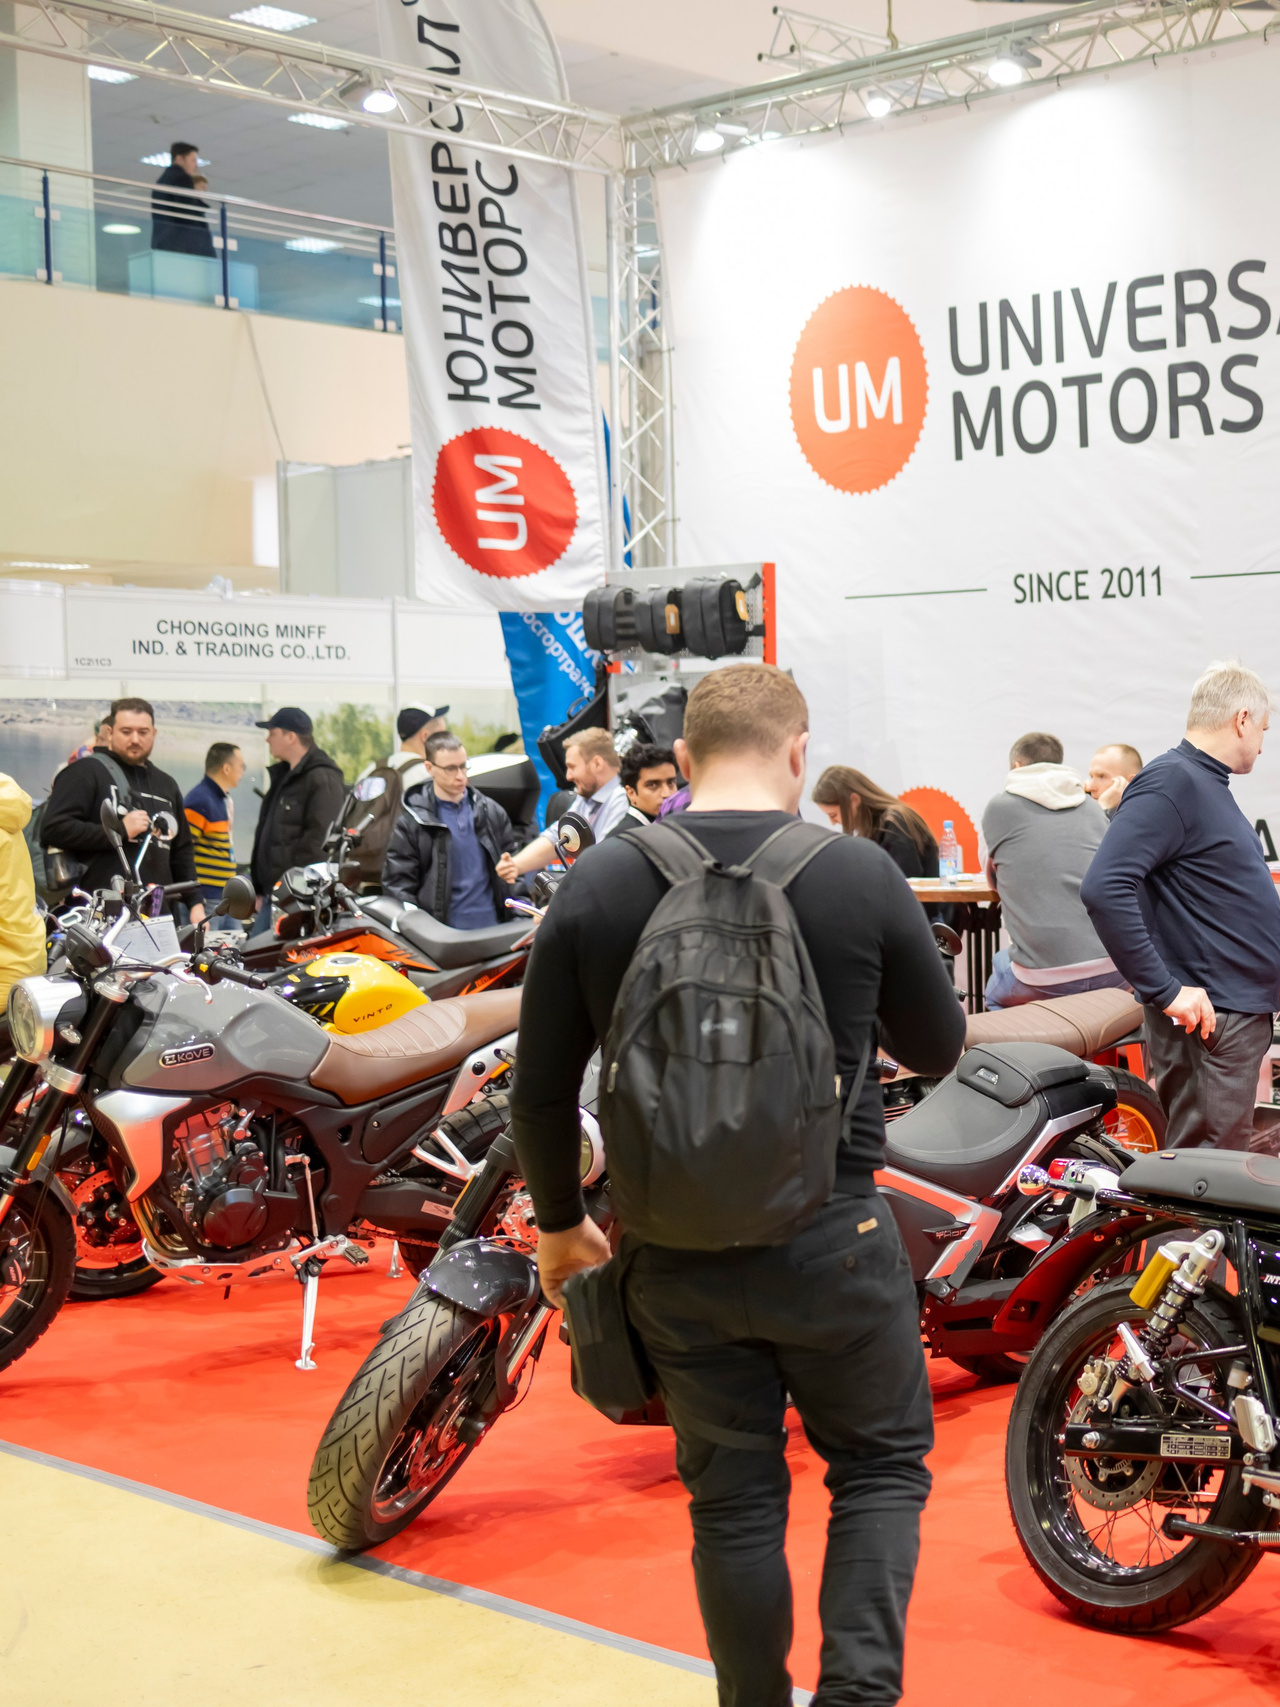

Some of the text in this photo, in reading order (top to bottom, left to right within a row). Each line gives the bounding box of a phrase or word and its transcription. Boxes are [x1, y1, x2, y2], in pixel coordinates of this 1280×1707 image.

[475, 159, 542, 411] МОТОРС
[812, 355, 904, 434] UM
[951, 353, 1265, 462] MOTORS
[473, 453, 528, 552] UM
[1013, 564, 1162, 604] SINCE 2011
[131, 639, 351, 662] IND. & TRADING CO.,LTD.
[156, 619, 327, 640] CHONGQING MINFF
[519, 611, 596, 699] осгортранс
[353, 1003, 393, 1023] VINTO
[177, 1047, 211, 1062] KOVE
